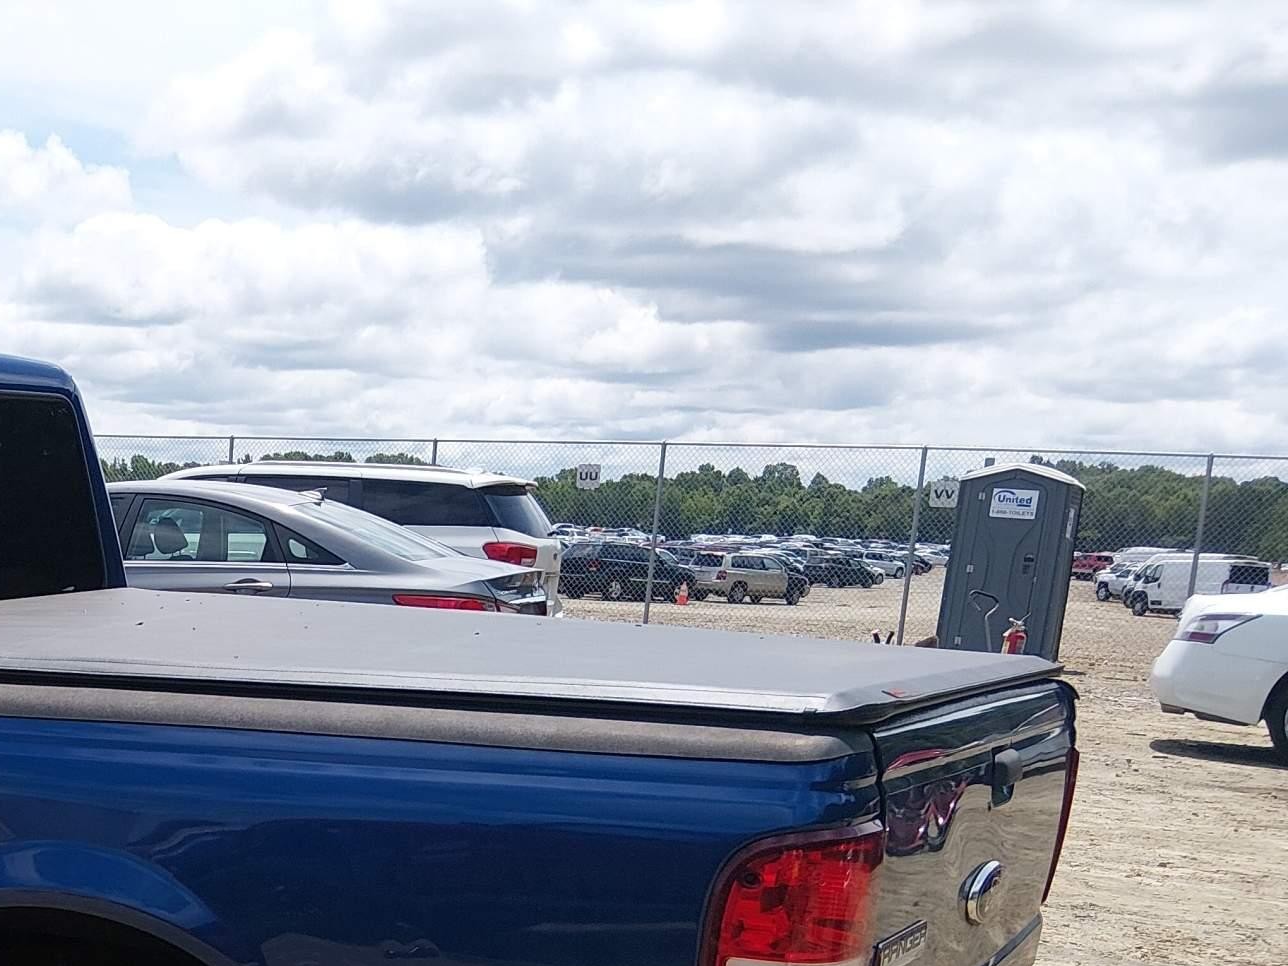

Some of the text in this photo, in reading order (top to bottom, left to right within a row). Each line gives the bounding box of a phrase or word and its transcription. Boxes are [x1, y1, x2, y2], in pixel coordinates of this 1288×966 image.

[579, 471, 599, 481] UU
[934, 489, 955, 499] VV
[998, 494, 1032, 504] United
[991, 509, 1034, 518] 1--TOILETS
[881, 925, 927, 966] RANGER
